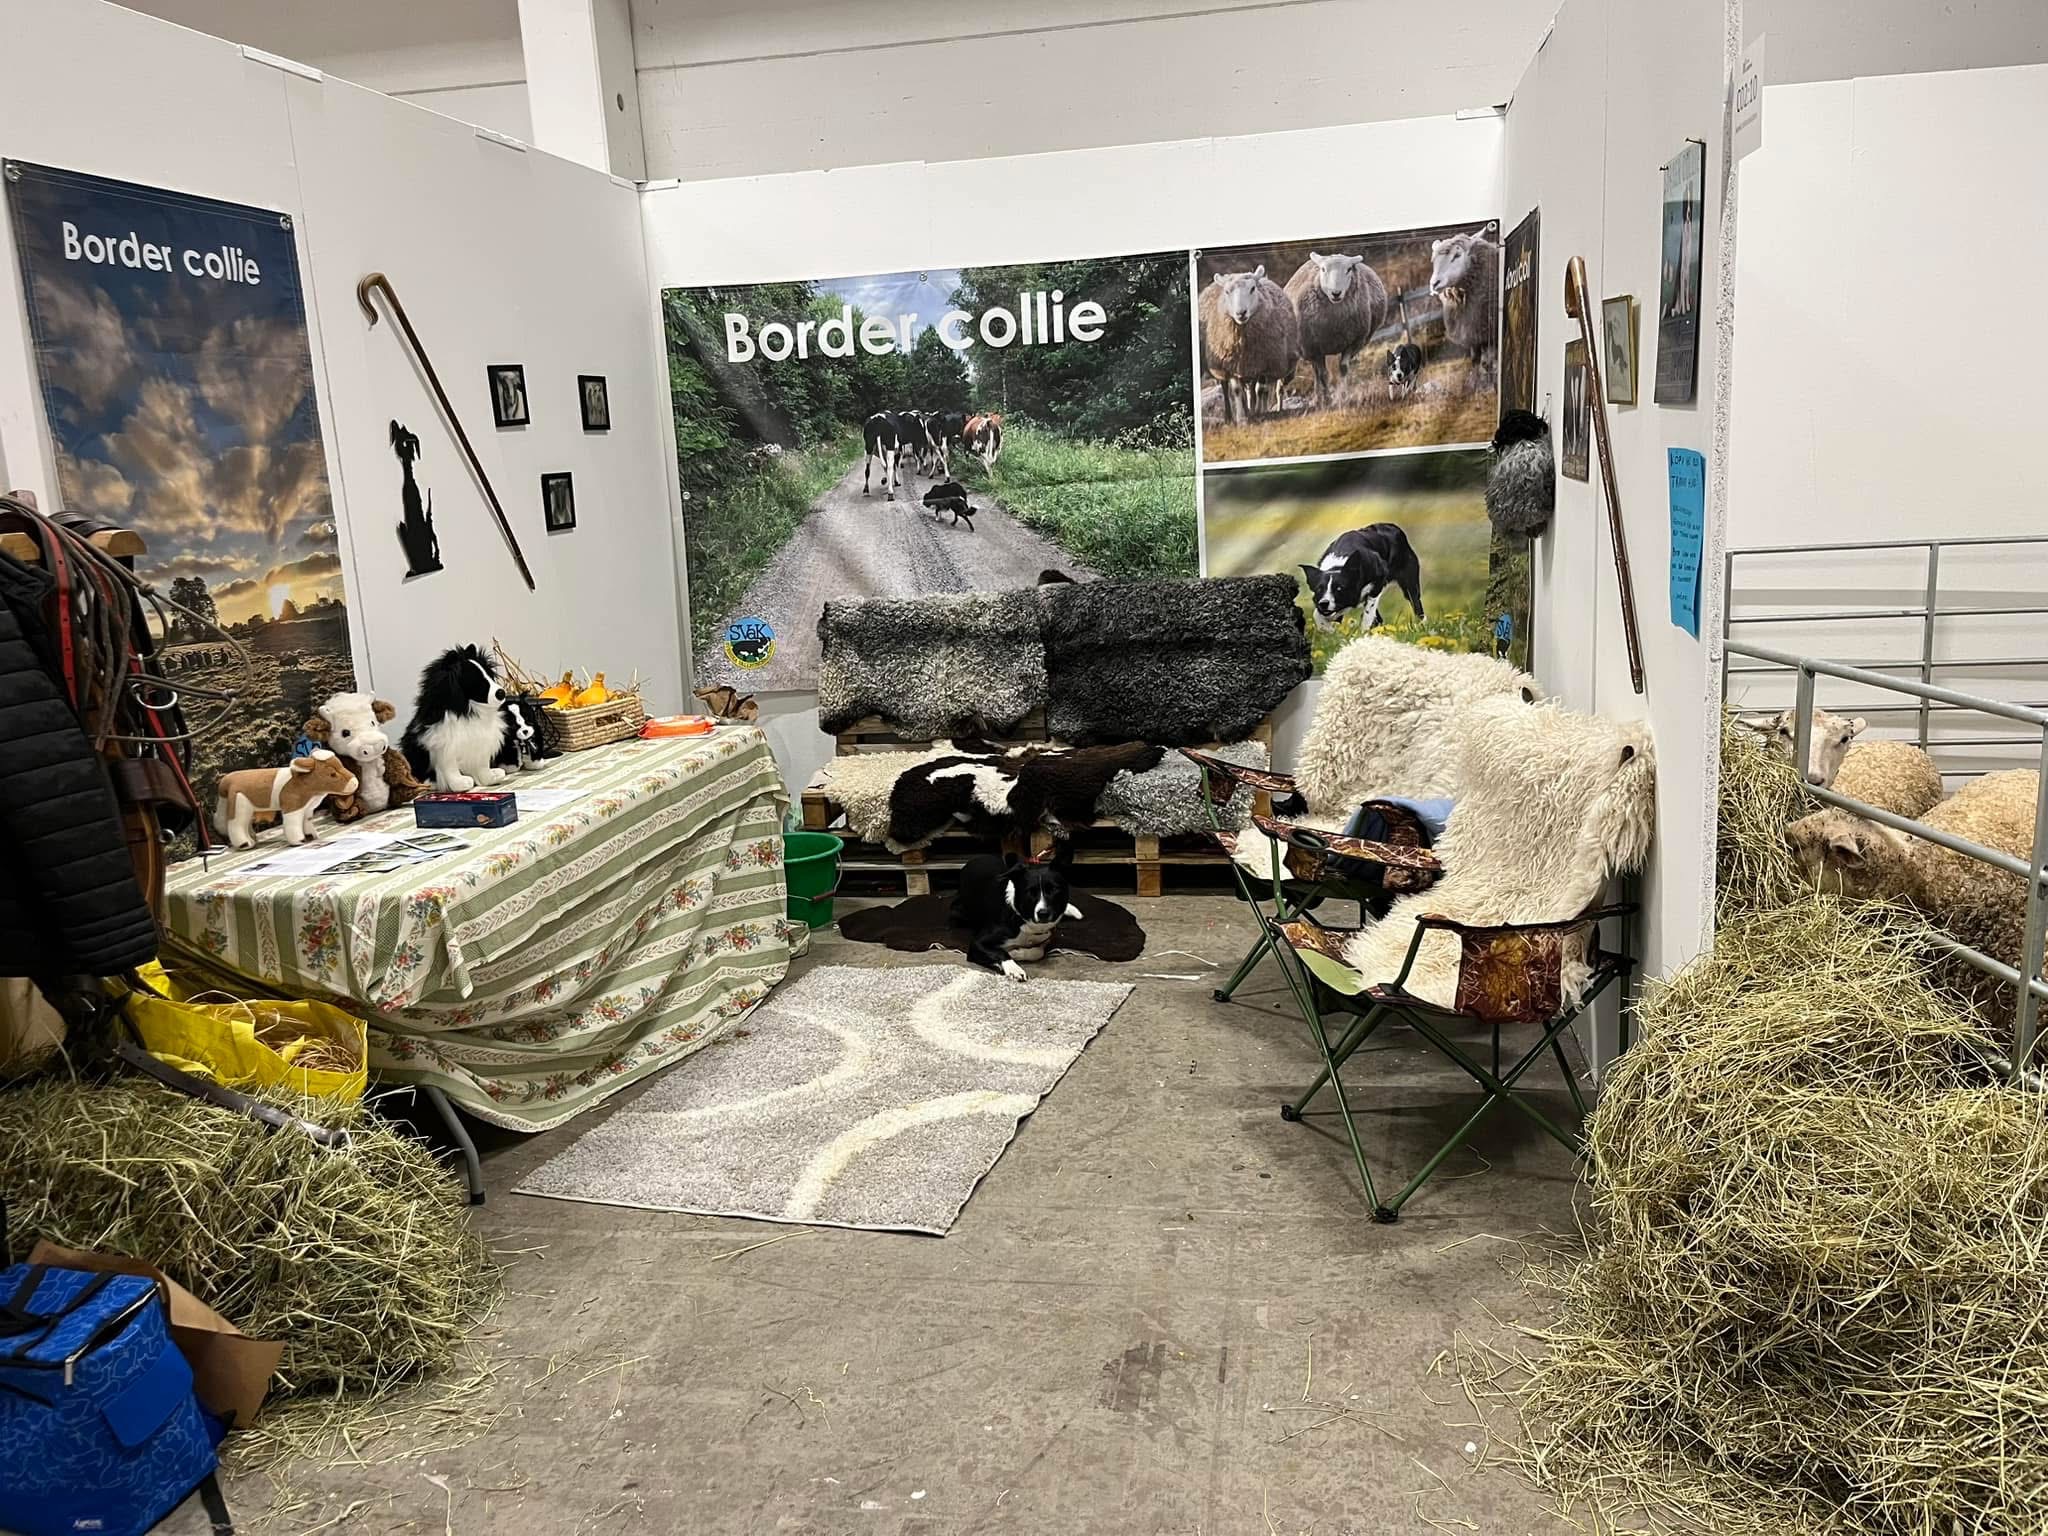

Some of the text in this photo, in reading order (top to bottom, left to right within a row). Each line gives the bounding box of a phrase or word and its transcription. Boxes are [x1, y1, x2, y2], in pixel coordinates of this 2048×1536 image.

[62, 221, 261, 286] Border collie
[723, 289, 1108, 364] Border collie
